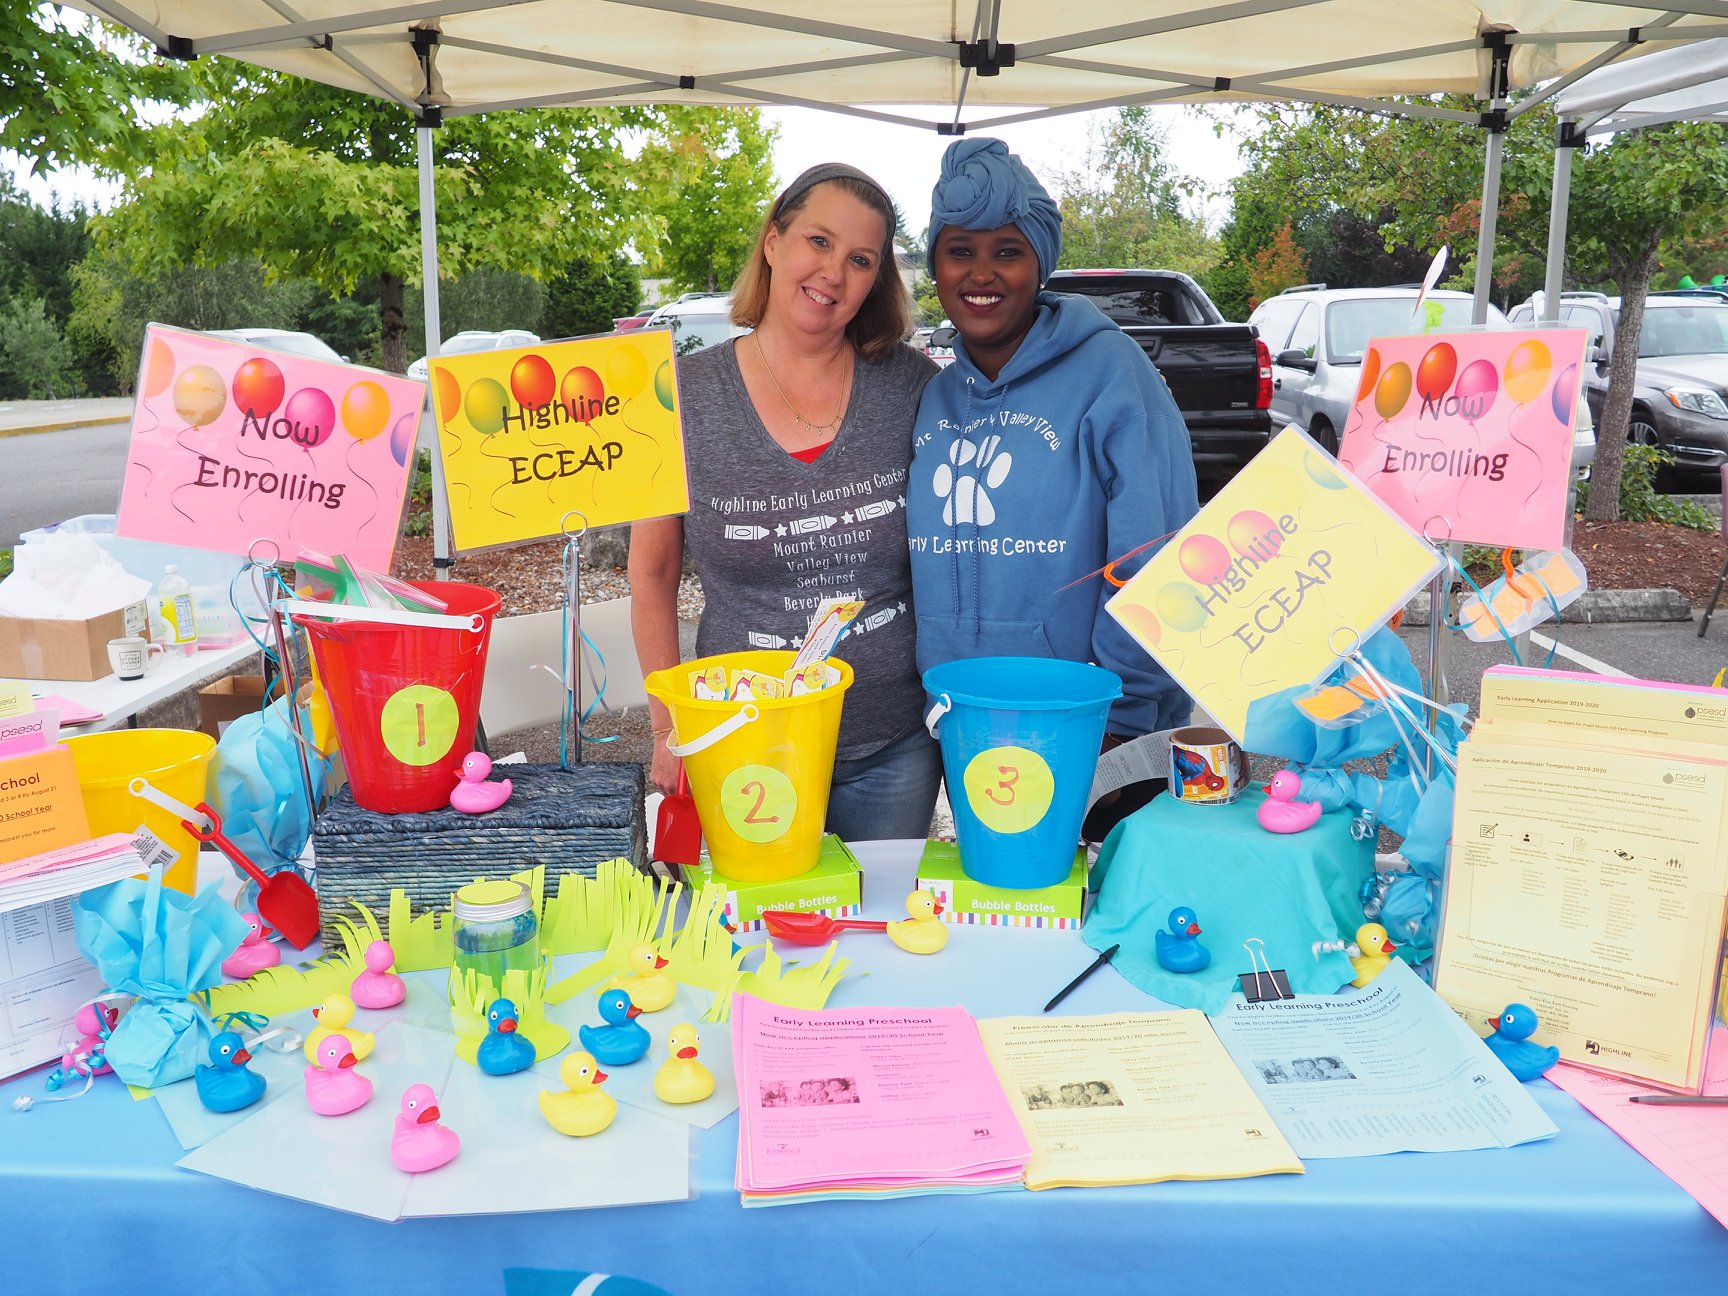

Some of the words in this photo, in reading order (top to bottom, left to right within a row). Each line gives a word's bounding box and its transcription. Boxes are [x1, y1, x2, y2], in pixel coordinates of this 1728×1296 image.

[502, 395, 620, 434] Highline
[1419, 391, 1484, 420] Now
[240, 407, 320, 446] Now
[937, 418, 987, 434] Ranier
[1000, 410, 1036, 427] Valley
[1033, 417, 1061, 451] View
[509, 441, 623, 484] ECEAP
[1382, 444, 1509, 481] Enrolling
[194, 456, 346, 509] Enrolling
[711, 497, 767, 515] Highline
[771, 491, 808, 510] Early
[812, 481, 871, 505] Learning
[873, 468, 906, 489] Center
[773, 540, 816, 558] Mount
[820, 528, 872, 548] Rainier
[907, 536, 927, 552] arly
[1002, 537, 1067, 556] Center
[786, 557, 830, 573] Valley
[834, 551, 868, 565] View
[1194, 512, 1299, 617] Highline
[796, 570, 856, 589] Seahurst
[1232, 549, 1333, 654] ECEAP
[1536, 697, 1568, 706] Application
[1569, 701, 1600, 709] 2019-2020
[1697, 707, 1727, 717] psesd
[0, 720, 43, 741] psesd
[415, 702, 426, 747] 1
[1545, 762, 1575, 770] Temprano
[1576, 766, 1607, 774] 2019-2020
[1675, 773, 1707, 783] psesd
[0, 772, 40, 791] chool
[31, 787, 50, 796] August
[984, 765, 1020, 806] 3
[6, 808, 33, 820] School
[35, 804, 52, 814] Year
[740, 780, 780, 824] 2
[756, 901, 796, 915] Bubble
[799, 894, 838, 908] Bottles
[971, 899, 1011, 912] Bubble
[1015, 900, 1056, 913] Bottles
[1505, 959, 1521, 968] elegir
[1522, 963, 1546, 974] nuestros
[1547, 969, 1578, 981] Programas
[1236, 1003, 1265, 1011] Early
[1269, 1002, 1323, 1011] Learning
[1324, 986, 1384, 1009] Preschool
[774, 1016, 803, 1027] Early
[808, 1018, 865, 1027] Learning
[1364, 1004, 1388, 1017] School
[760, 1031, 777, 1039] Now
[1600, 1046, 1633, 1059] HIGHLINE
